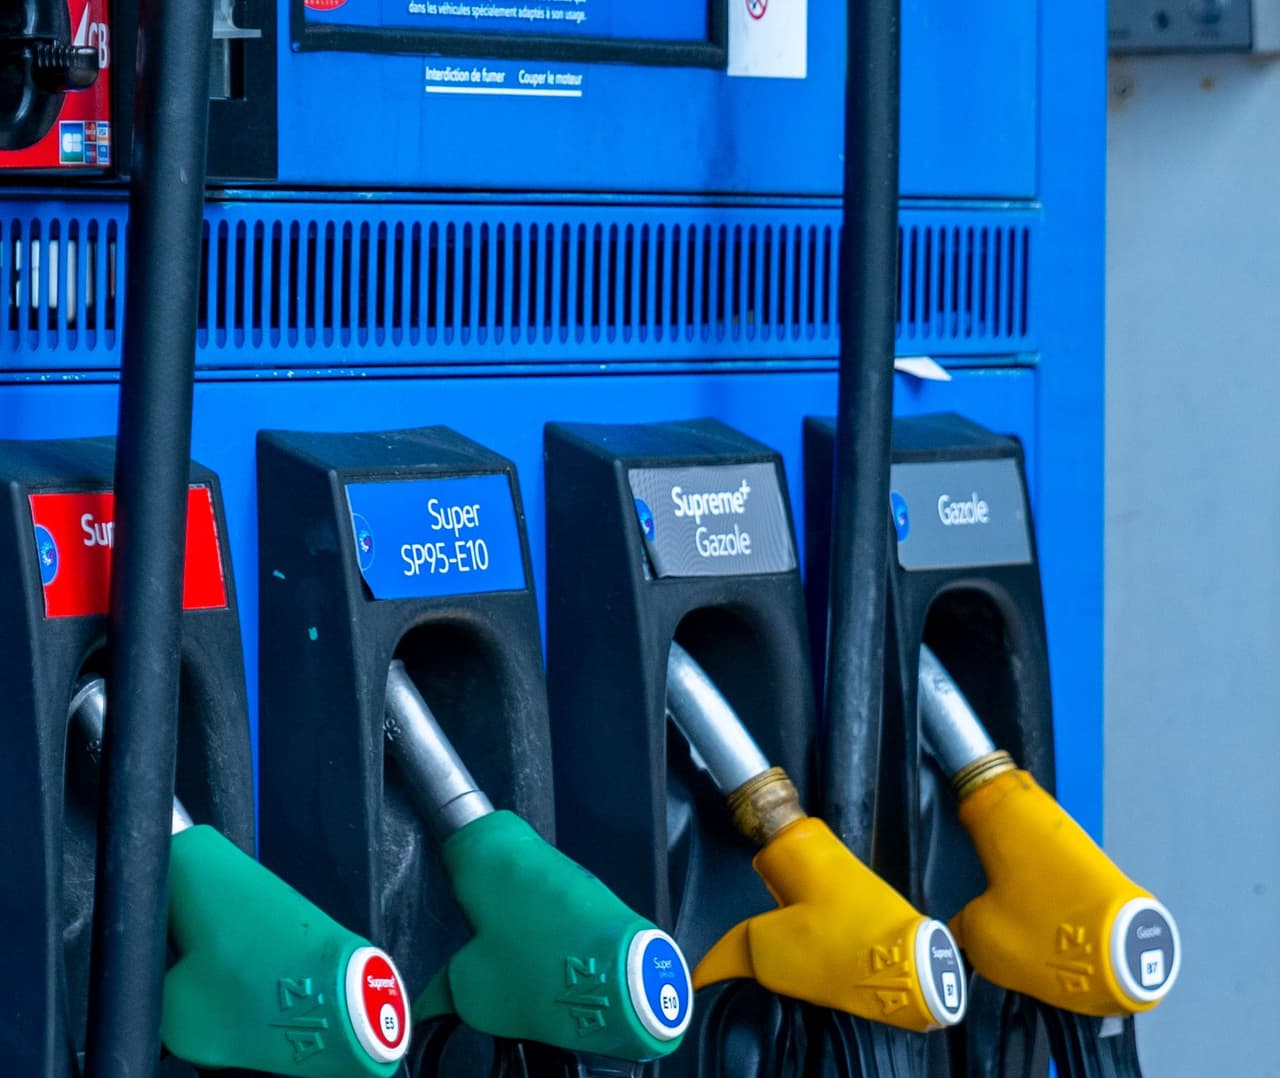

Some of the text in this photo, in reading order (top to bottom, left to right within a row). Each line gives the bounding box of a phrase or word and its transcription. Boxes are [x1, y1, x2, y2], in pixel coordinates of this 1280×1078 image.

[425, 65, 506, 83] Interdiction de fumer
[519, 69, 583, 88] Couper le moteur
[428, 498, 480, 534] Super
[672, 480, 751, 520] Supreme+
[937, 494, 989, 526] Gazole
[696, 523, 752, 557] Gazole
[401, 540, 489, 577] SP95-E10
[663, 995, 677, 1009] E10
